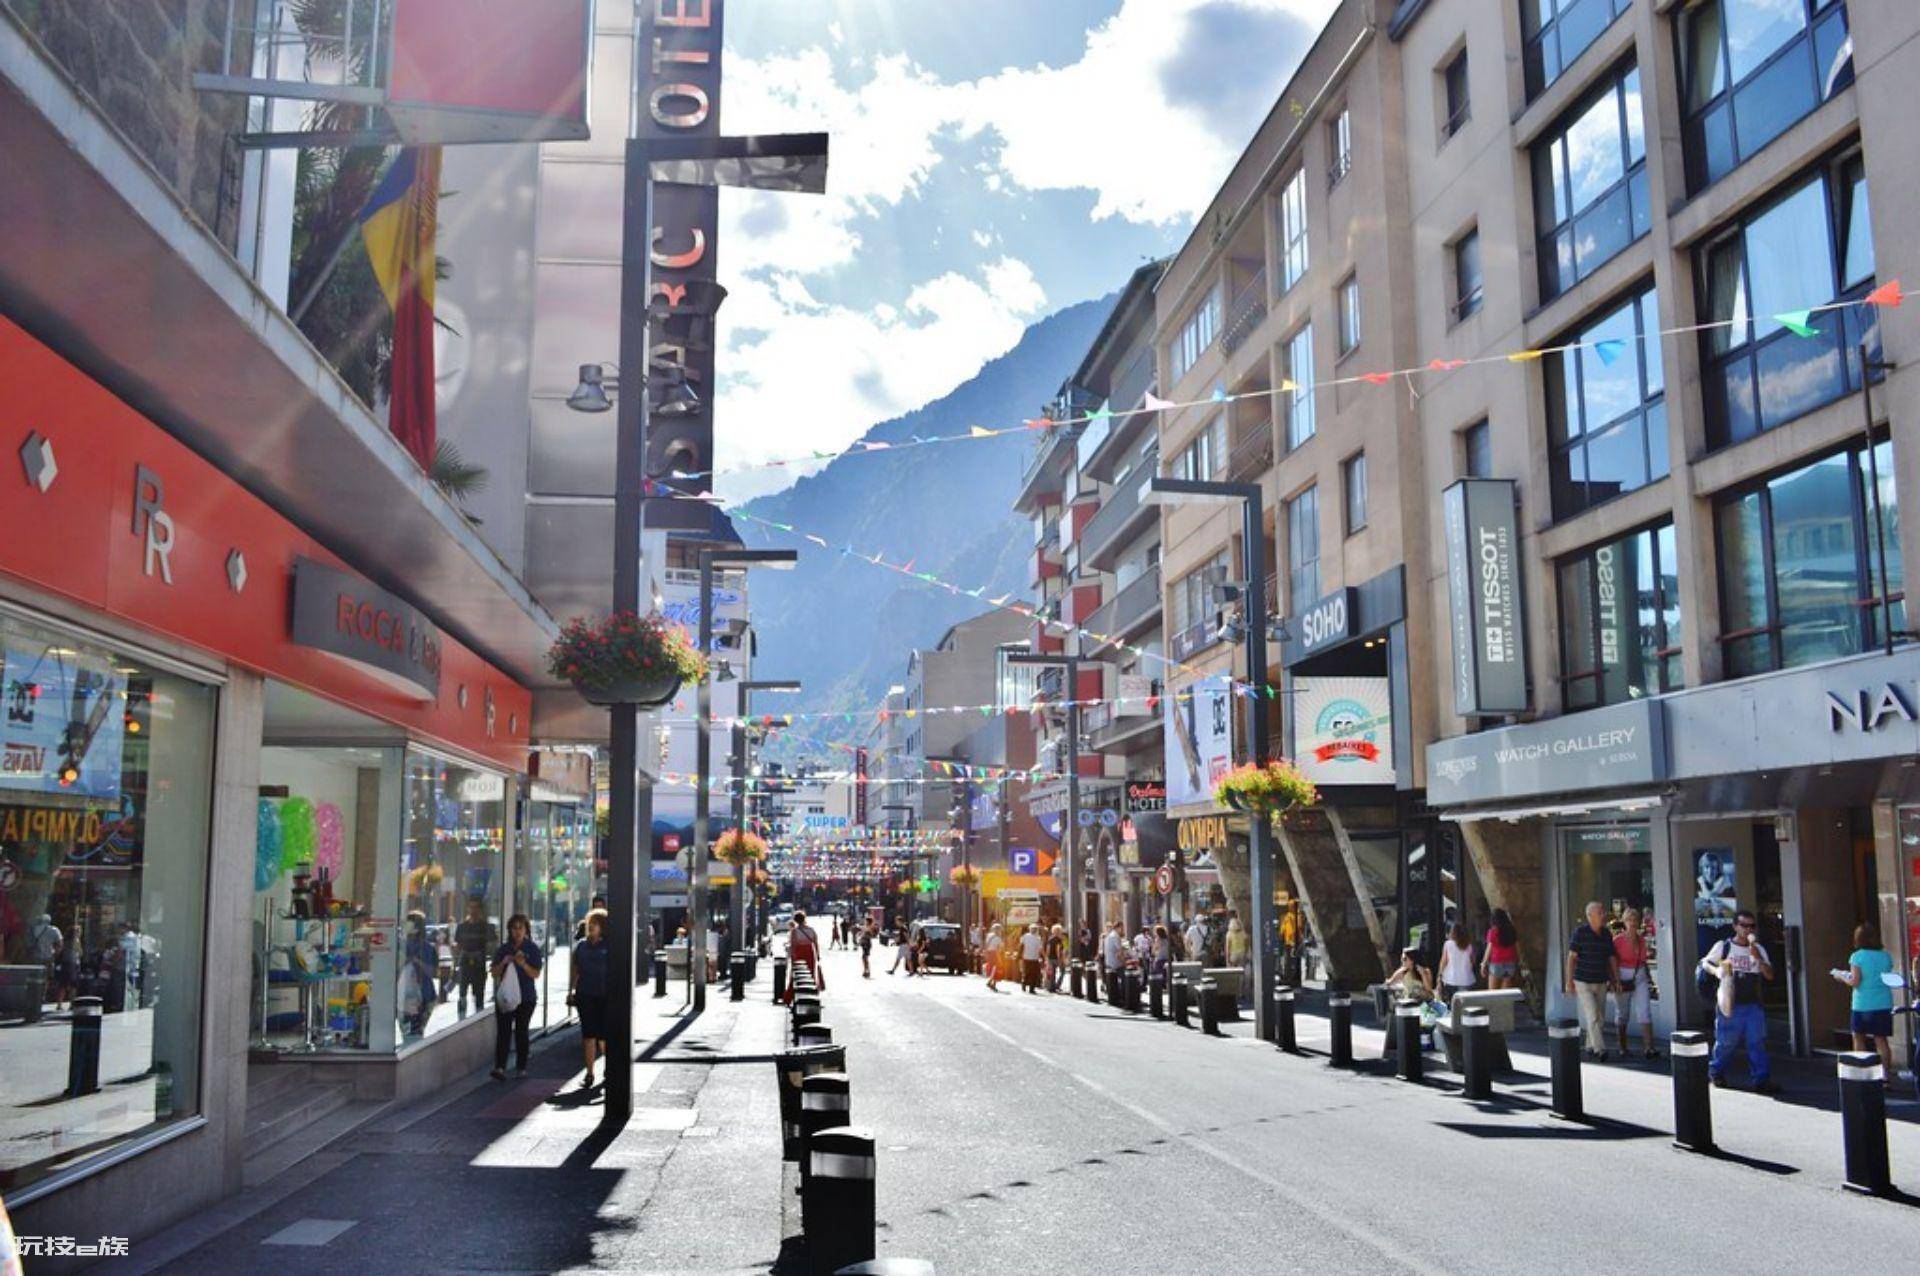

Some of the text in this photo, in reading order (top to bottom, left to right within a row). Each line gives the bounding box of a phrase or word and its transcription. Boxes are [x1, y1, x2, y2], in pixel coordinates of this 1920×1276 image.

[650, 0, 709, 128] OTE
[1480, 526, 1502, 624] TISSOT
[337, 593, 405, 656] ROCA
[1303, 597, 1345, 647] SOHO
[1503, 629, 1514, 663] SWISS
[1827, 681, 1920, 732] NA
[1495, 727, 1636, 764] WATCH GALLERY
[804, 816, 847, 827] SUPER
[1177, 816, 1228, 850] OLYMPIA
[1014, 852, 1031, 872] P
